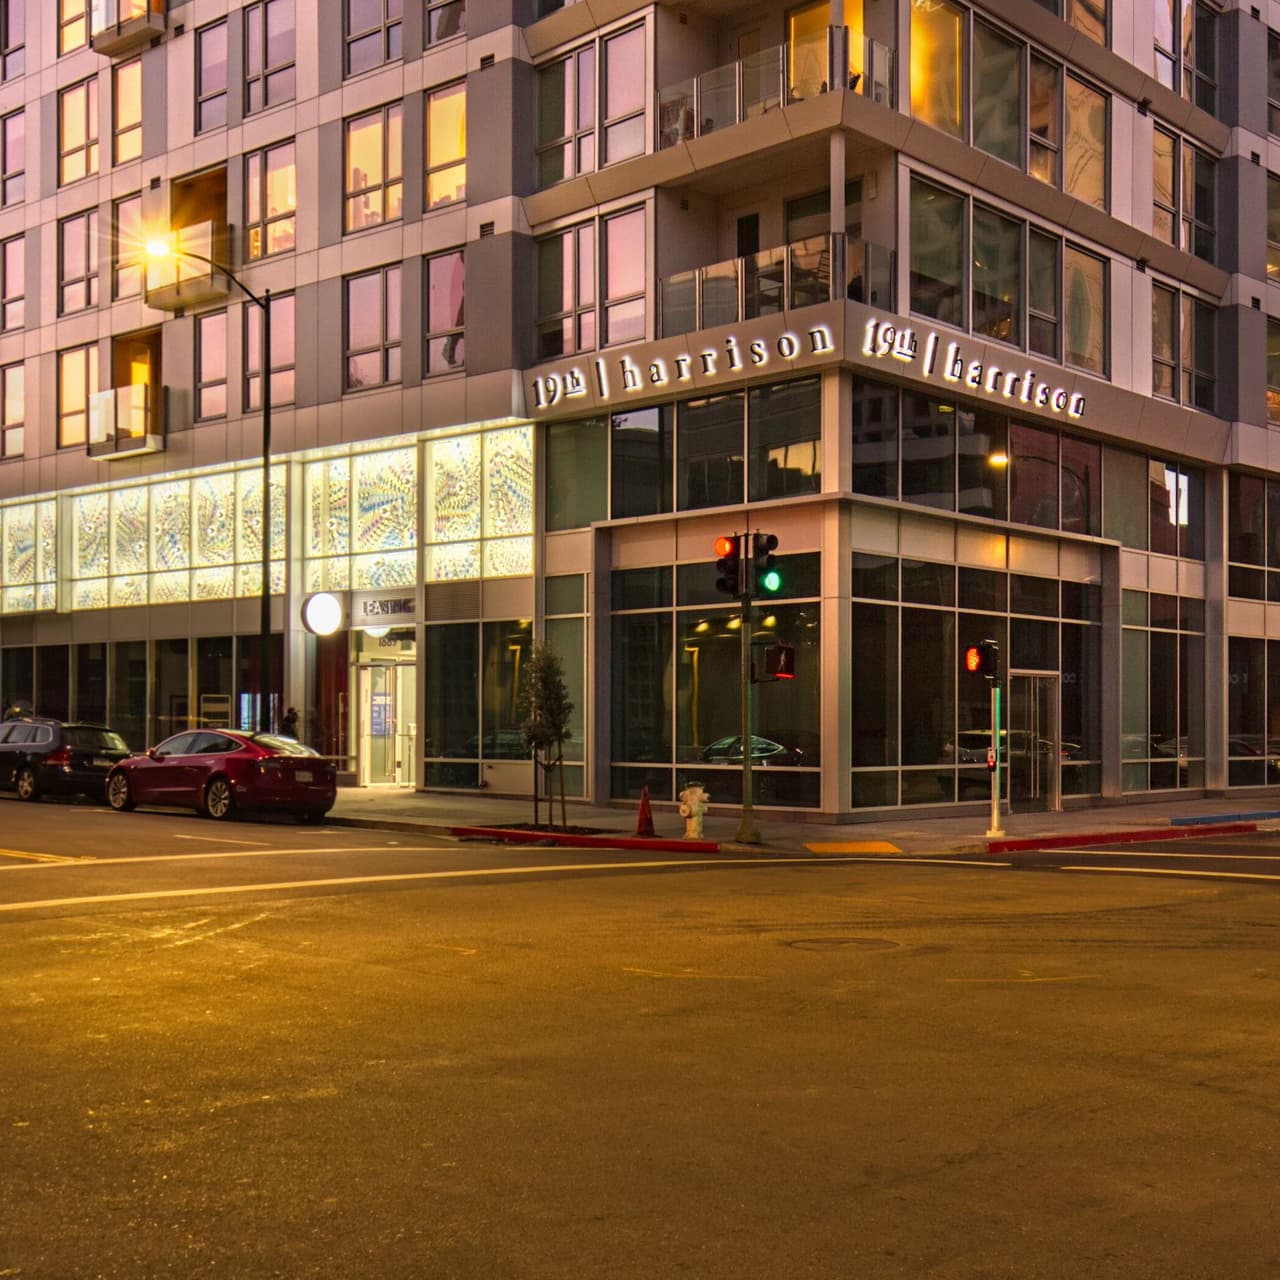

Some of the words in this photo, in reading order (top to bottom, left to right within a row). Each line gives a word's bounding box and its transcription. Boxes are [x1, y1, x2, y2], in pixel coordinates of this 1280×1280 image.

[532, 369, 587, 408] 19th
[619, 327, 835, 392] harrison
[862, 318, 917, 362] 19th
[944, 341, 1085, 418] harrison
